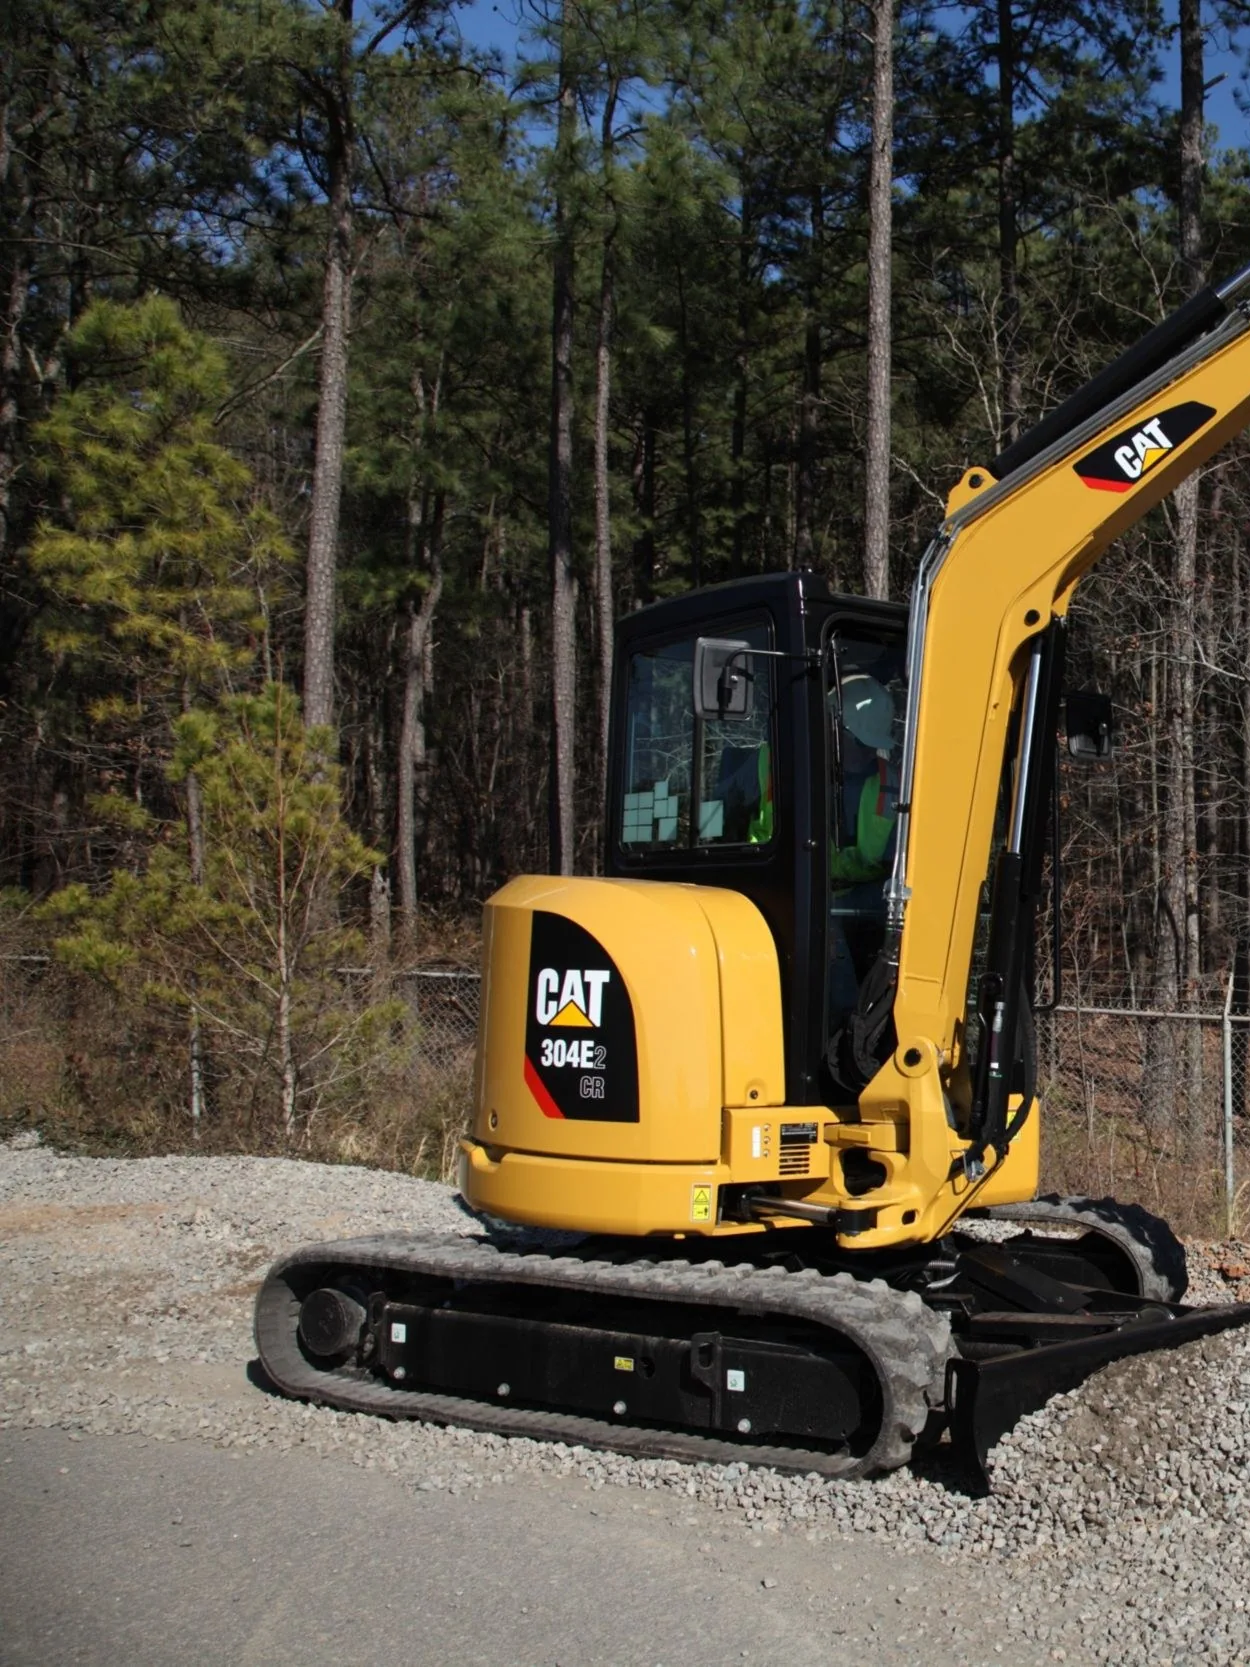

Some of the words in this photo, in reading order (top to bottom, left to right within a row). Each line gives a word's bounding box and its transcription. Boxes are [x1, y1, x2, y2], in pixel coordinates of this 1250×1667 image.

[1113, 417, 1174, 479] CAT
[535, 967, 610, 1028] CAT
[540, 1038, 607, 1069] 304E2
[579, 1075, 605, 1099] CR
